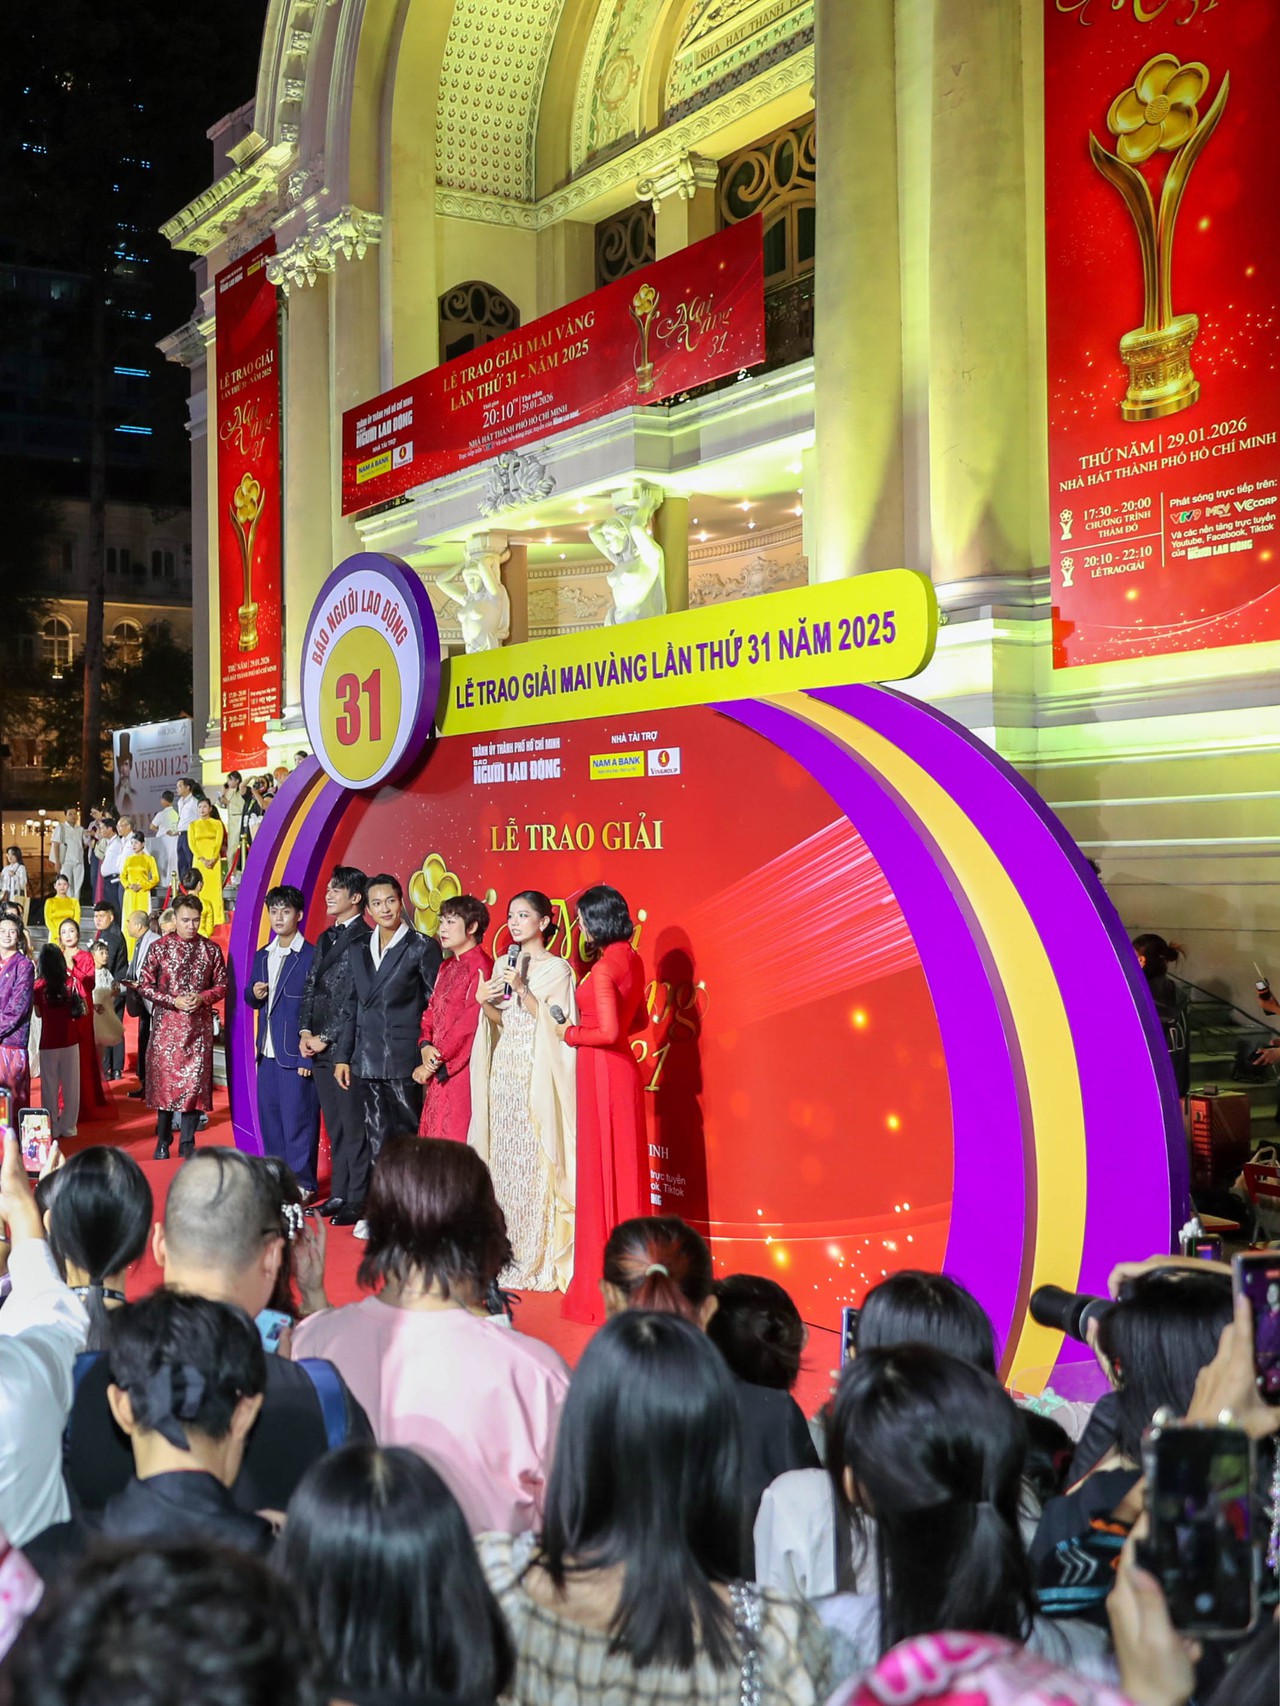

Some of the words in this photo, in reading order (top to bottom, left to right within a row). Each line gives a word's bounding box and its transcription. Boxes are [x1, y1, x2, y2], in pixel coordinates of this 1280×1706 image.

[460, 358, 493, 384] TRAO
[496, 342, 523, 368] GIẢI
[526, 331, 552, 355] MAI
[555, 310, 595, 341] VÀNG
[708, 331, 728, 358] 31
[231, 361, 254, 384] TRAO
[476, 371, 504, 399] THỨ
[505, 370, 517, 388] 31
[528, 351, 559, 379] NĂM
[562, 338, 589, 364] 2025
[483, 401, 514, 428] 20:10
[522, 393, 554, 413] 29.01.2026
[1078, 446, 1113, 470] THỨ
[1116, 438, 1156, 461] NĂM
[1166, 416, 1248, 450] 29.01.2026
[375, 457, 389, 466] BANK
[1058, 475, 1085, 493] NHÀ
[1087, 467, 1113, 486] HÁT
[1114, 459, 1158, 481] THÀNH
[1160, 449, 1187, 471] PHỐ
[1211, 438, 1236, 459] CHÍ
[1238, 431, 1277, 451] MINH
[1169, 497, 1190, 508] Phát
[1192, 492, 1214, 503] sóng
[1216, 488, 1235, 498] trực
[1236, 482, 1254, 494] tiếp
[1256, 479, 1278, 490] trên:
[1084, 505, 1112, 521] 17:30
[1121, 496, 1152, 513] 20:00
[1124, 510, 1151, 523] TRÌNH
[1170, 508, 1202, 525] VTV9
[1171, 531, 1182, 539] Và
[1183, 528, 1198, 538] các
[1235, 518, 1252, 528] trực
[1206, 529, 1248, 542] Facebook,
[1249, 523, 1275, 534] Tiktok
[1084, 552, 1113, 568] 20:10
[1122, 545, 1153, 561] 22:10
[1102, 564, 1126, 576] TRAO
[311, 628, 331, 666] BÁO
[326, 587, 358, 632] NGƯỜI
[361, 589, 382, 616] LAO
[380, 598, 409, 647] ĐỘNG
[456, 678, 474, 709] LỄ
[477, 675, 520, 706] TRAO
[522, 664, 556, 699] GIẢI
[560, 663, 592, 693] MAI
[594, 651, 647, 688] VÀNG
[652, 641, 692, 679] LẦN
[695, 629, 743, 672] THỨ
[747, 631, 771, 664] 31
[778, 616, 832, 660] NĂM
[838, 610, 896, 651] 2025
[335, 668, 382, 746] 31
[611, 732, 627, 744] NHÀ
[628, 731, 640, 742] TÀI
[641, 730, 658, 742] TRỢ
[134, 756, 167, 780] VERDI
[170, 754, 189, 776] 125
[507, 761, 528, 782] LAO
[530, 757, 561, 781] ĐỘNG
[593, 759, 611, 768] NAM
[612, 758, 618, 766] A
[618, 756, 640, 766] BANK
[490, 817, 520, 851] LỄ
[525, 822, 595, 851] TRAO
[601, 811, 663, 850] GIẢI
[648, 1143, 669, 1160] INH
